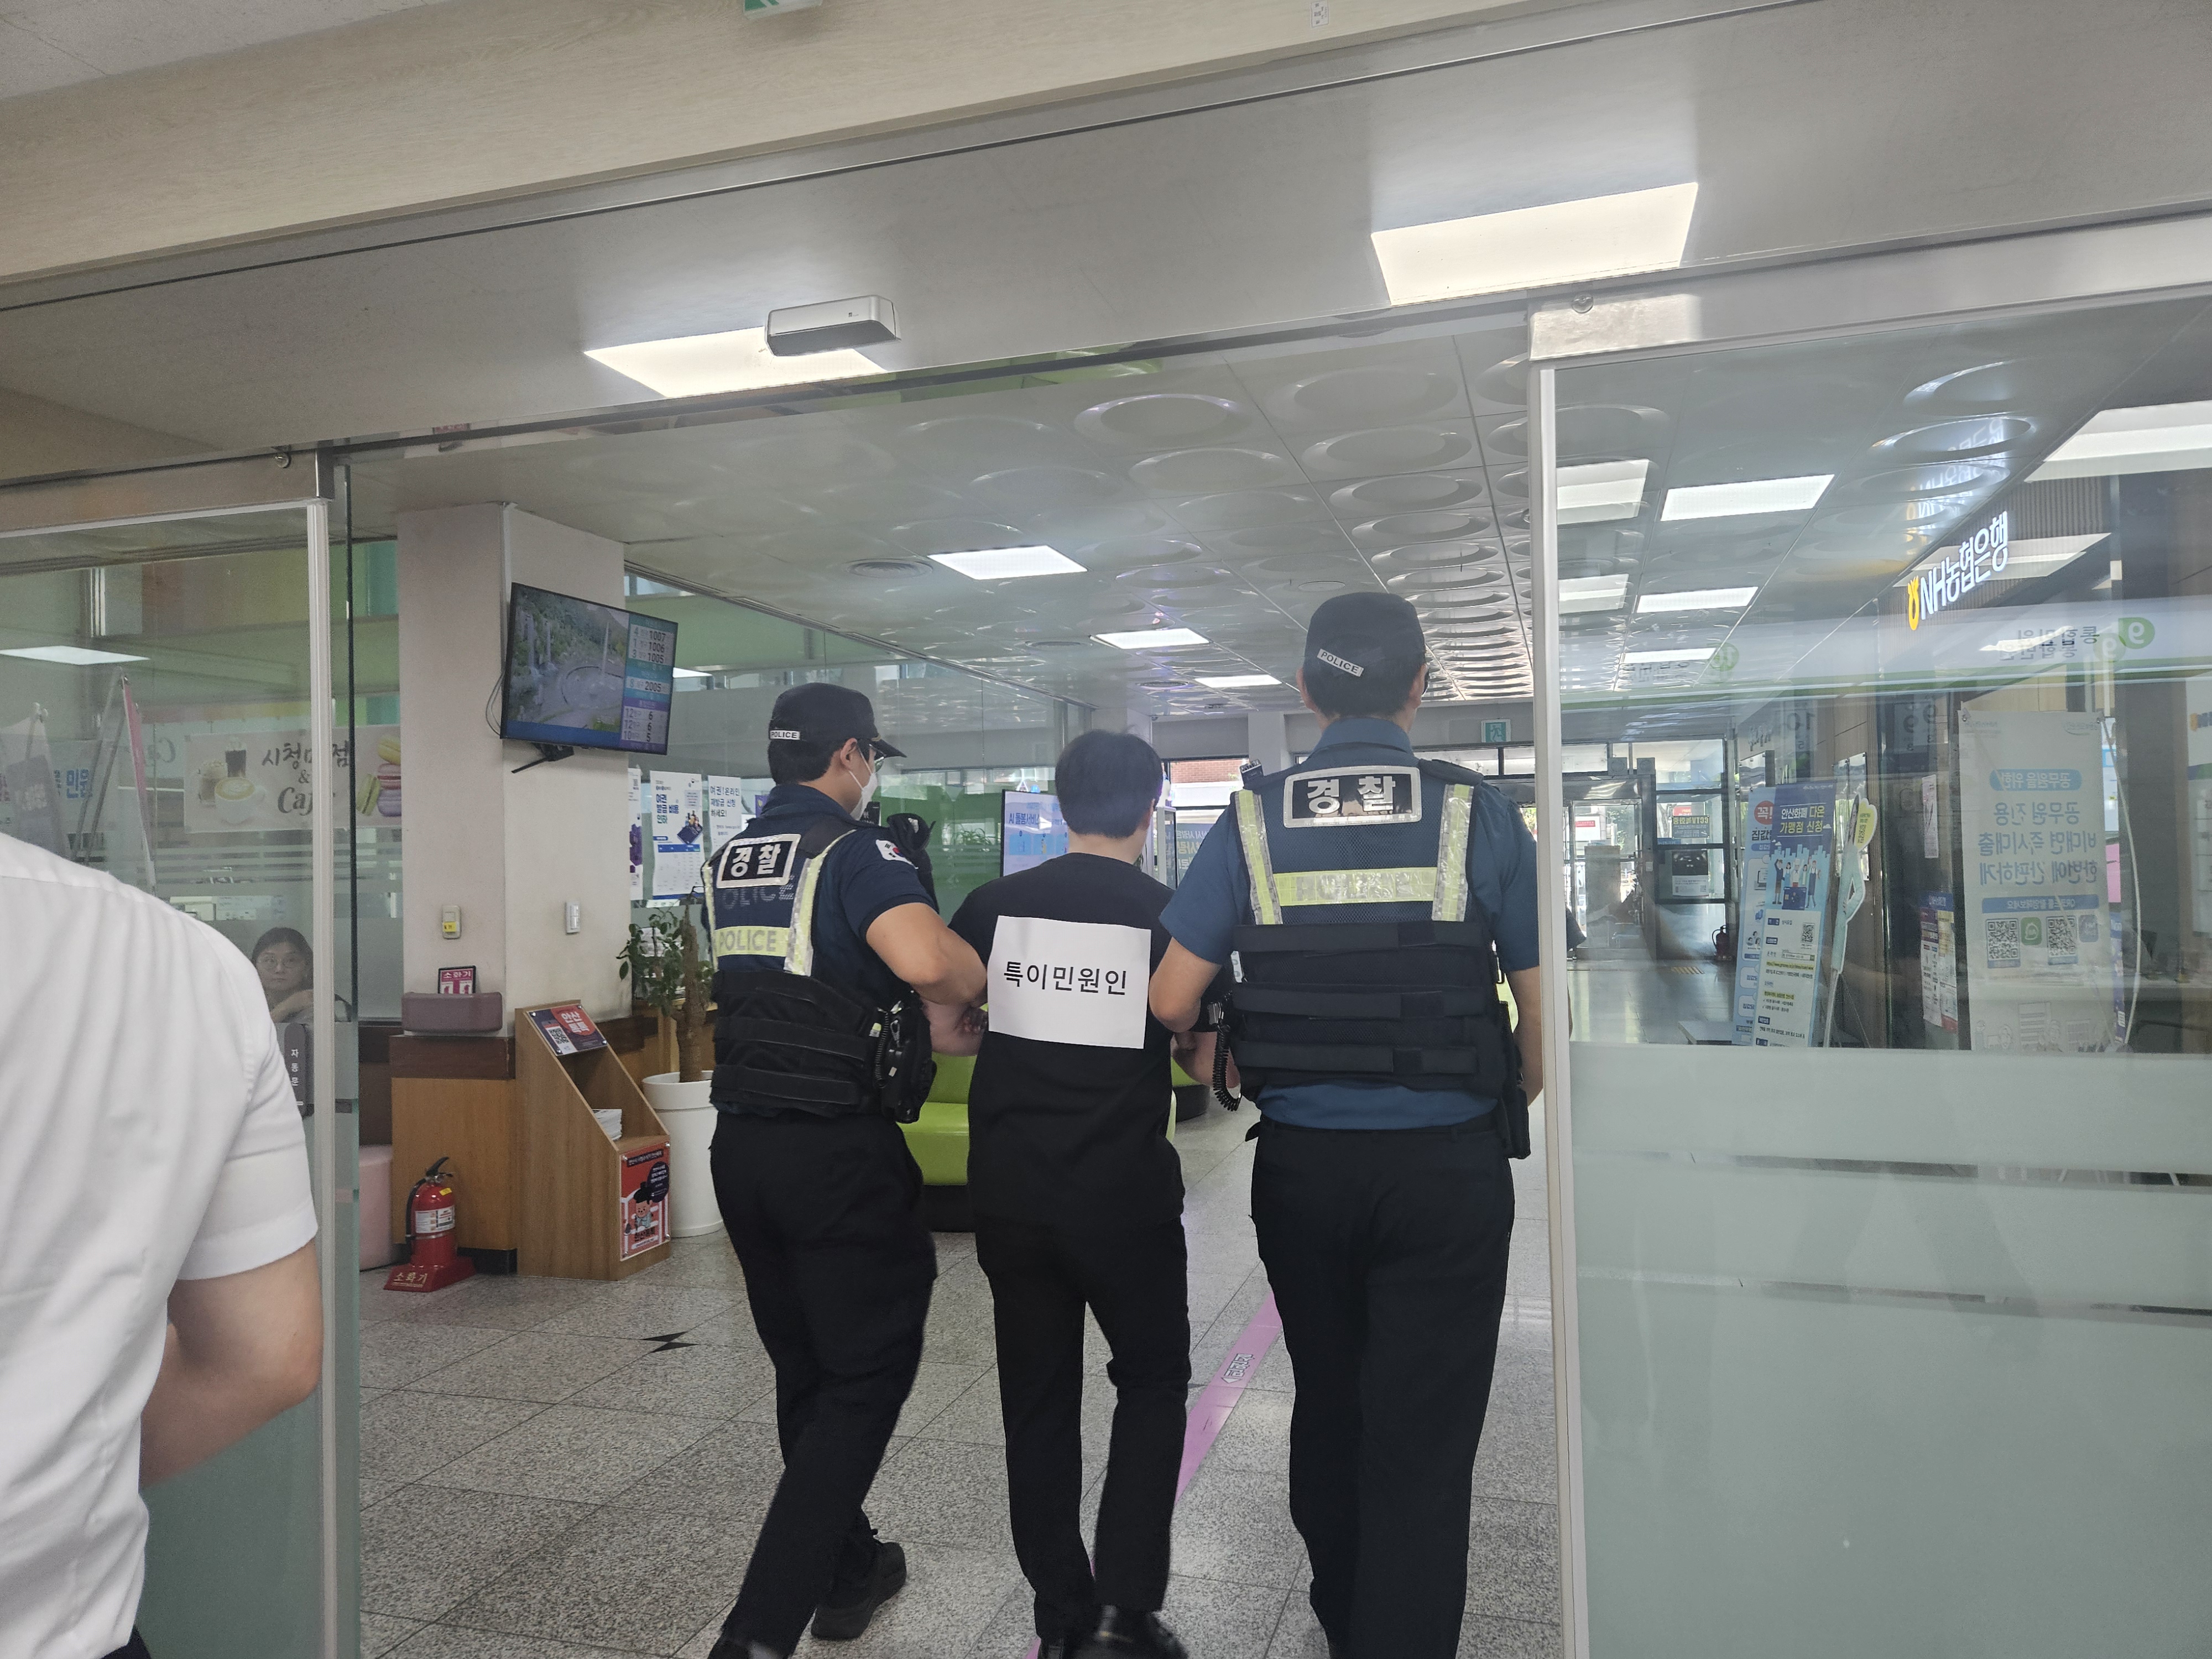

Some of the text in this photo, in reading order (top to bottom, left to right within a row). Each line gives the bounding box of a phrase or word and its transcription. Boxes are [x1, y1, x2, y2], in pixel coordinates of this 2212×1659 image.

[1919, 511, 2008, 620] NH농협은행
[649, 630, 666, 641] 1007
[649, 641, 665, 653] 1006
[648, 653, 664, 664] 1005
[1321, 651, 1359, 675] POLICE
[645, 681, 662, 692] 2005
[648, 711, 653, 720] 6
[648, 722, 652, 731] 6
[646, 733, 651, 742] 5
[278, 786, 336, 816] Ca
[1307, 775, 1396, 815] 경찰
[1757, 806, 1773, 820] 꼭!
[1781, 806, 1825, 820] 안산화폐 다온
[1780, 821, 1823, 833] 가맹점 신청
[1751, 830, 1772, 841] 집값
[731, 843, 781, 878] 경찰
[722, 883, 794, 910] OLICE
[719, 930, 776, 952] POLICE
[443, 971, 472, 979] 소화기
[1003, 961, 1127, 995] 특이민원인
[561, 1011, 582, 1024] 안산
[291, 1048, 299, 1086] 자동문
[393, 1272, 428, 1285] 소화기
